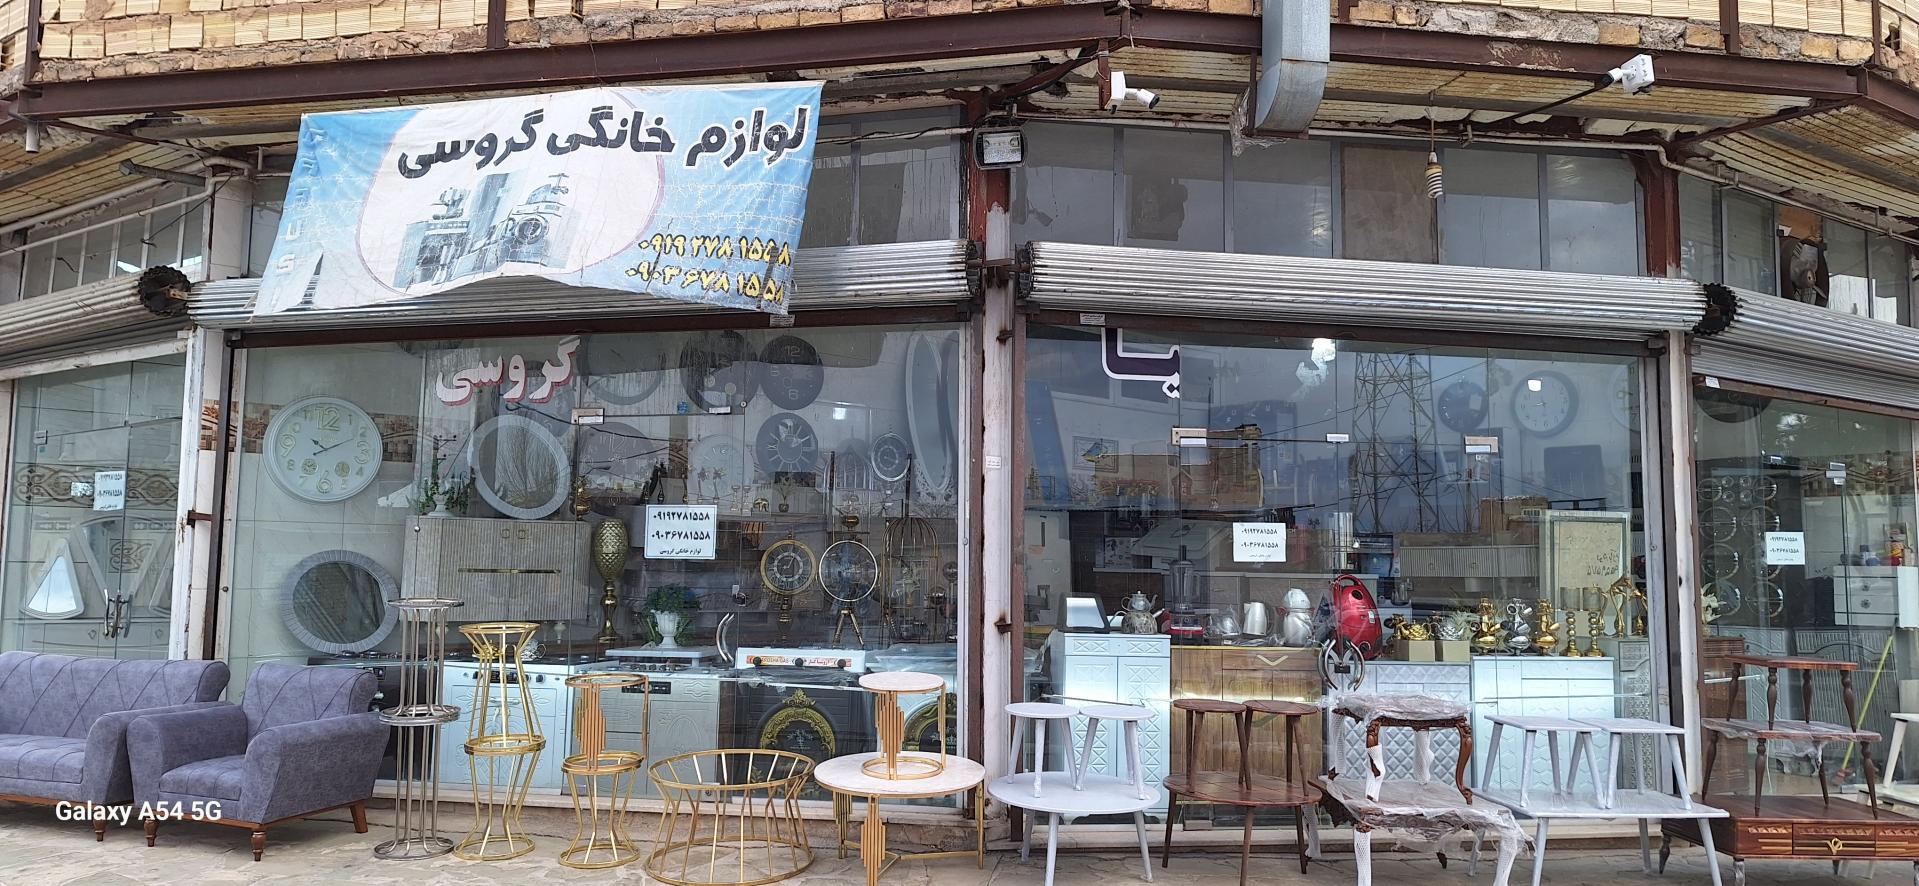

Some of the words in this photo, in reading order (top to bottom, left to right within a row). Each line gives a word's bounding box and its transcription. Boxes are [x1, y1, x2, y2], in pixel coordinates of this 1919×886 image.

[398, 108, 544, 179] گروسی
[547, 105, 675, 157] خانگی
[684, 106, 809, 168] لوازم
[638, 233, 687, 257] ۰۹۱۹
[691, 235, 734, 259] ۲۷۸
[435, 334, 581, 406] گروسی
[315, 406, 340, 431] 12
[280, 432, 297, 457] 9
[353, 440, 370, 465] 3
[316, 469, 333, 494] 6
[653, 511, 711, 521] ۰۹۱۹۲۷۸۱۵۵۸
[651, 530, 711, 541] ۰۹۰۳۶۷۸۱۵۵۸
